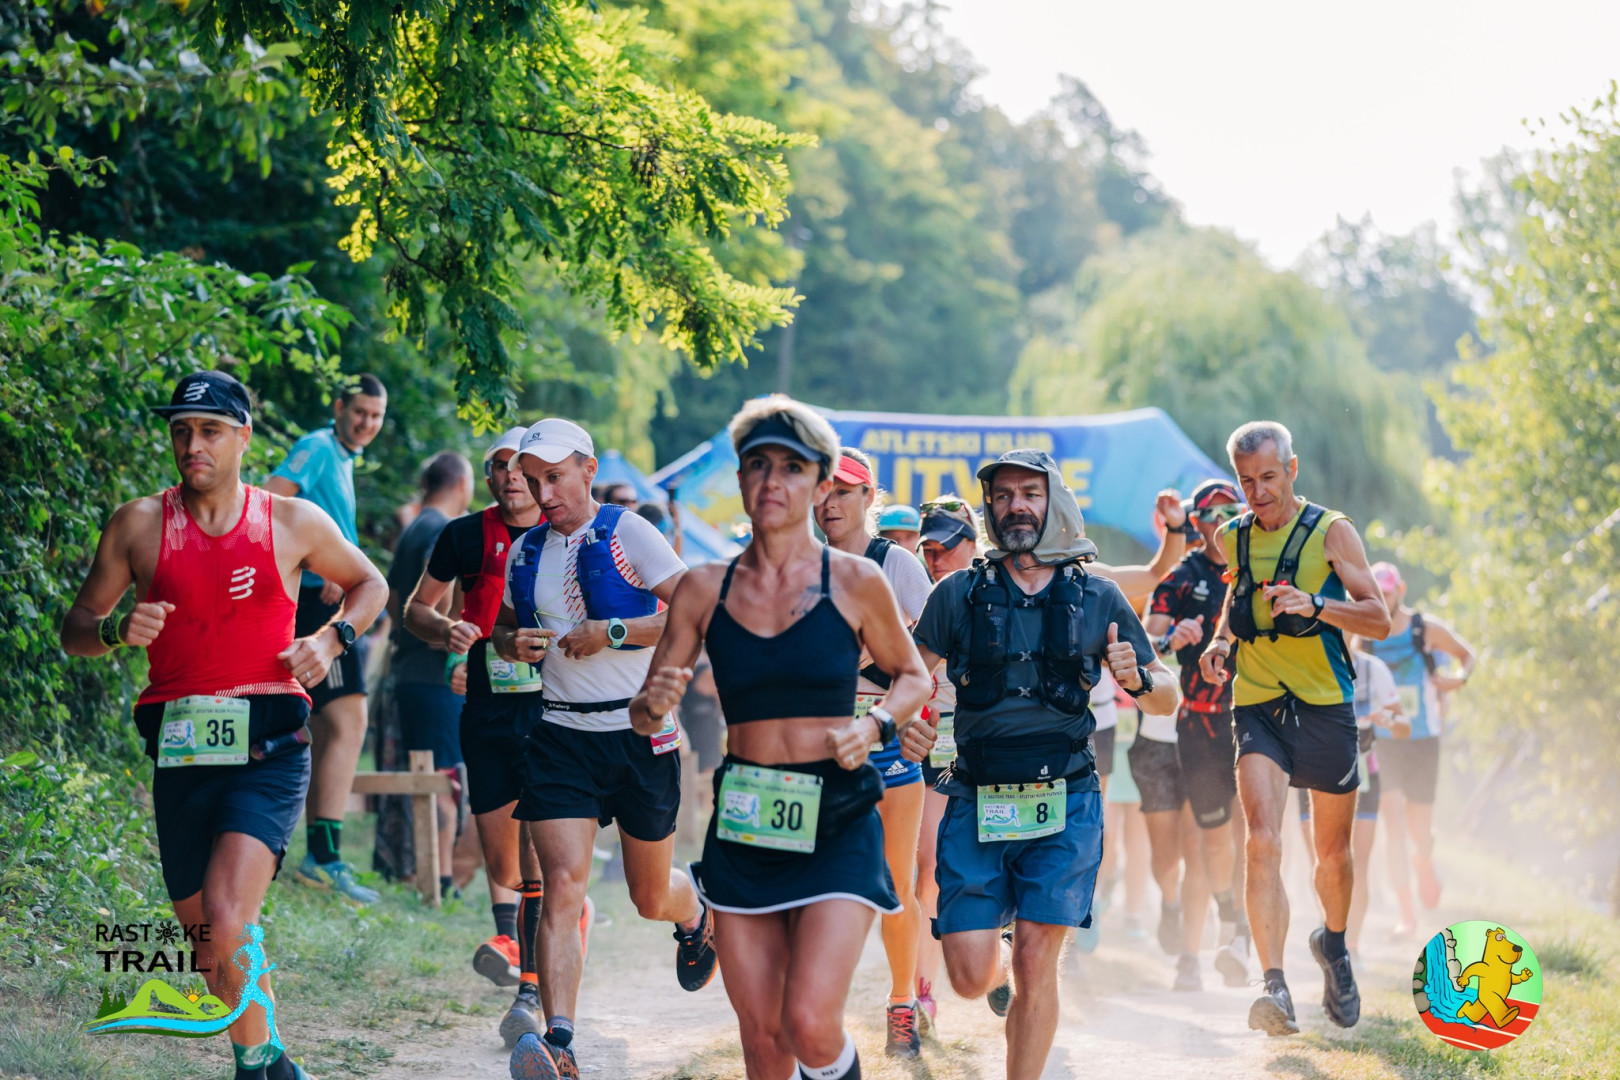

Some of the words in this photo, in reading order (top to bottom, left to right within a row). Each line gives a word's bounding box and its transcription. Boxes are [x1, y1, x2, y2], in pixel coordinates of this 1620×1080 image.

[860, 428, 982, 456] ATLETSKI
[984, 432, 1055, 455] KLUB
[206, 719, 235, 747] 35
[885, 766, 909, 776] adidas
[771, 799, 803, 832] 30
[1036, 802, 1048, 824] 8
